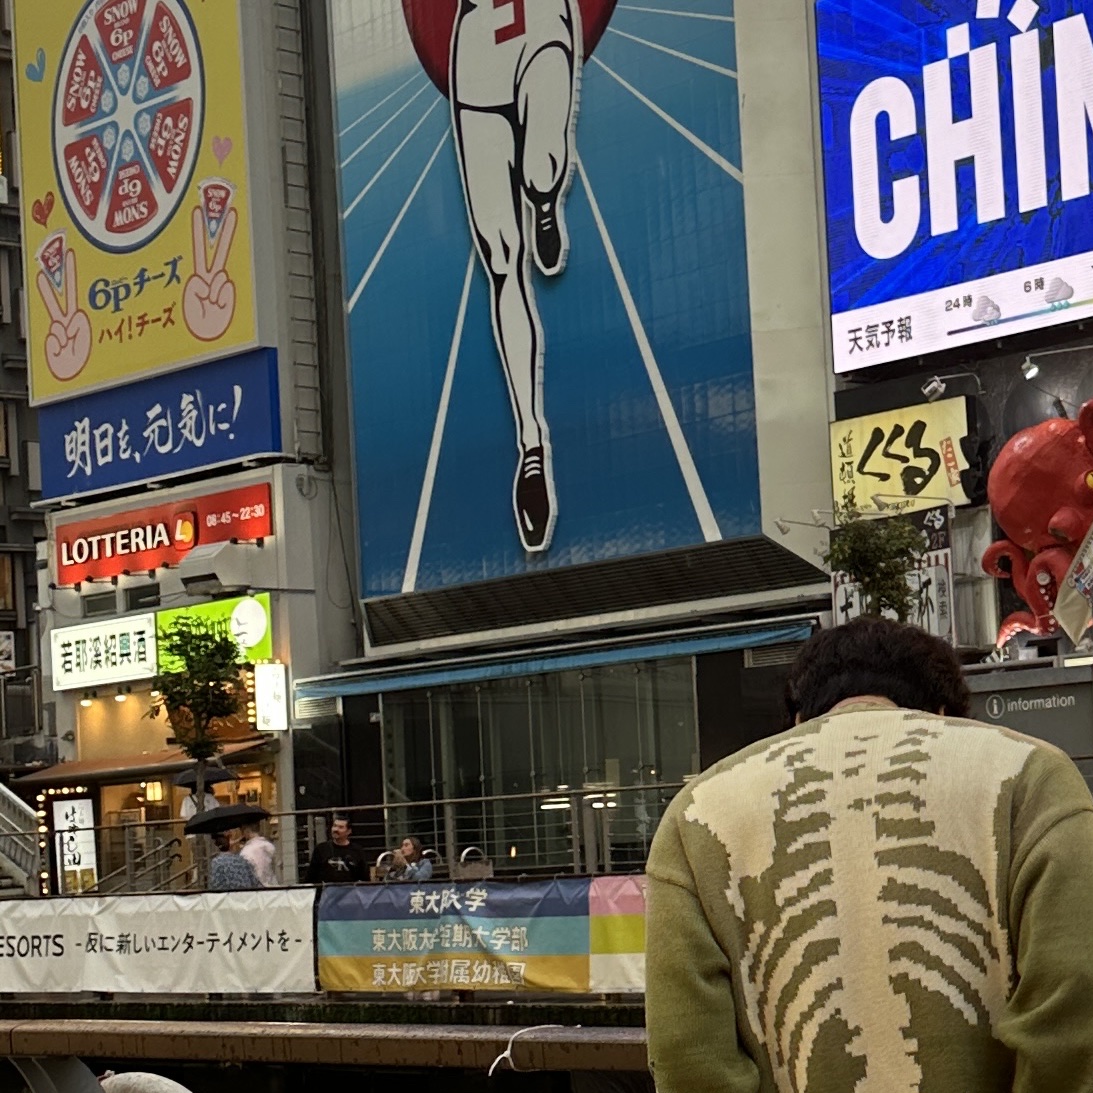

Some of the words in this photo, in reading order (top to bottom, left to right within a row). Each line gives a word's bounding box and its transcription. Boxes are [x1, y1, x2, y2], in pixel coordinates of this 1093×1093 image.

[103, 0, 138, 25] SNOW
[159, 15, 187, 68] SNOW
[66, 49, 86, 112] SNOW
[167, 114, 189, 180] SNOW
[68, 155, 94, 206] SNOW
[112, 201, 149, 228] SNOW
[945, 294, 973, 312] 24時
[1023, 277, 1045, 293] 6時
[847, 315, 913, 356] 天気予報
[857, 420, 941, 496] くくる
[61, 522, 170, 566] LOTTERIA
[1007, 693, 1076, 712] information
